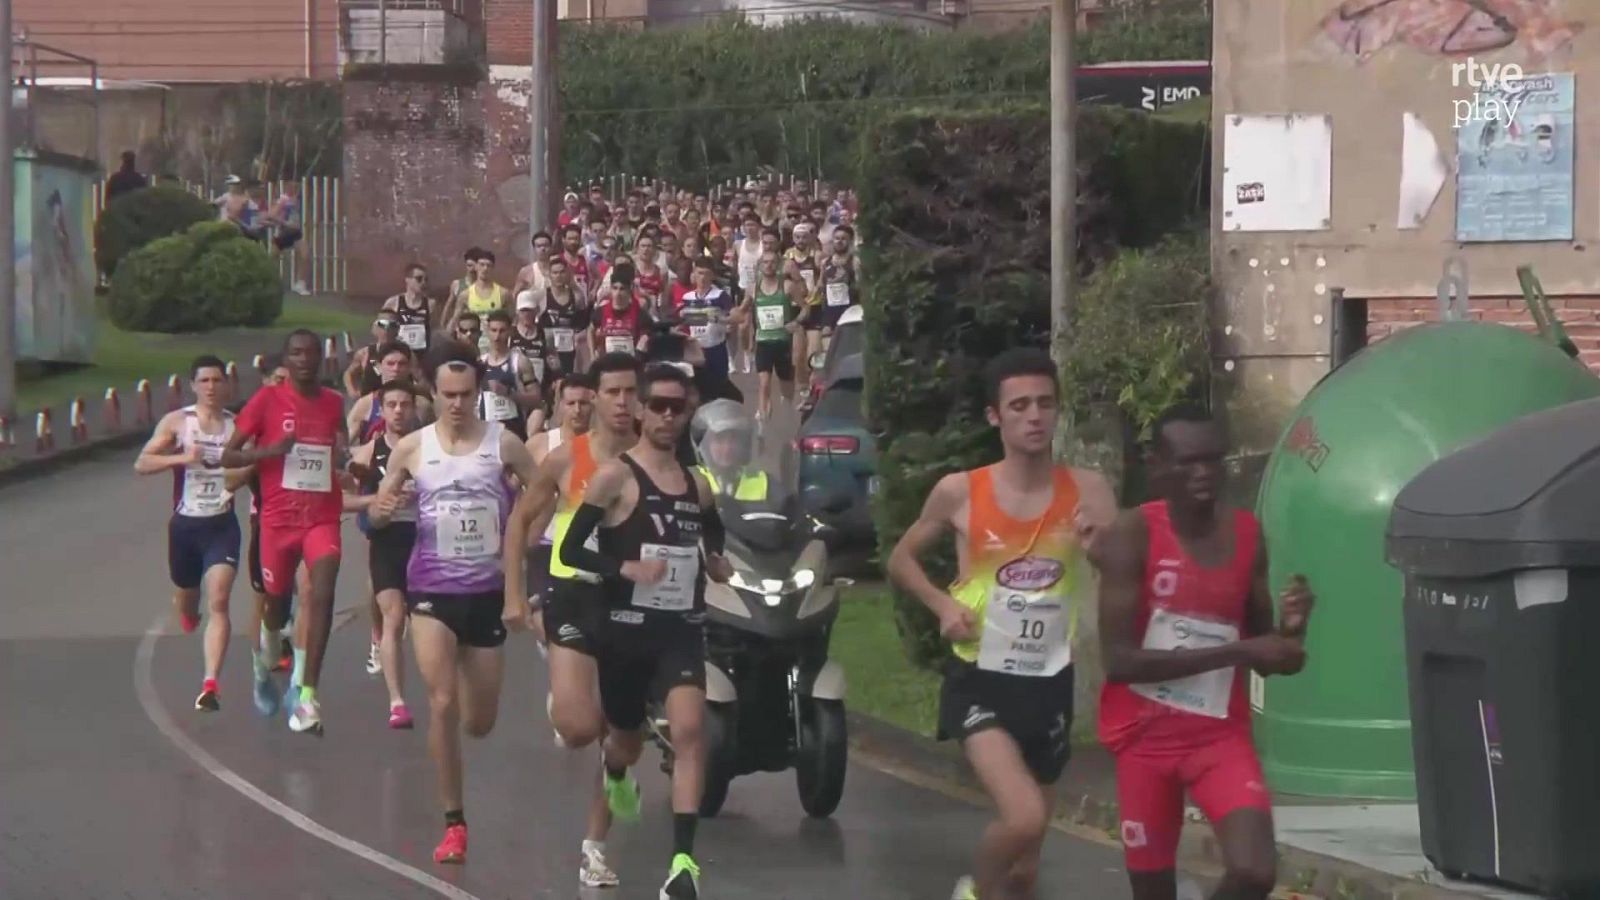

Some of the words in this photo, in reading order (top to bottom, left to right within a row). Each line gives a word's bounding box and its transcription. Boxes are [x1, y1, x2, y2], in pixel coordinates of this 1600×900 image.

[299, 459, 323, 472] 379
[201, 481, 217, 493] 77
[460, 519, 478, 533] 12
[669, 567, 678, 582] 1
[1017, 619, 1045, 640] 10
